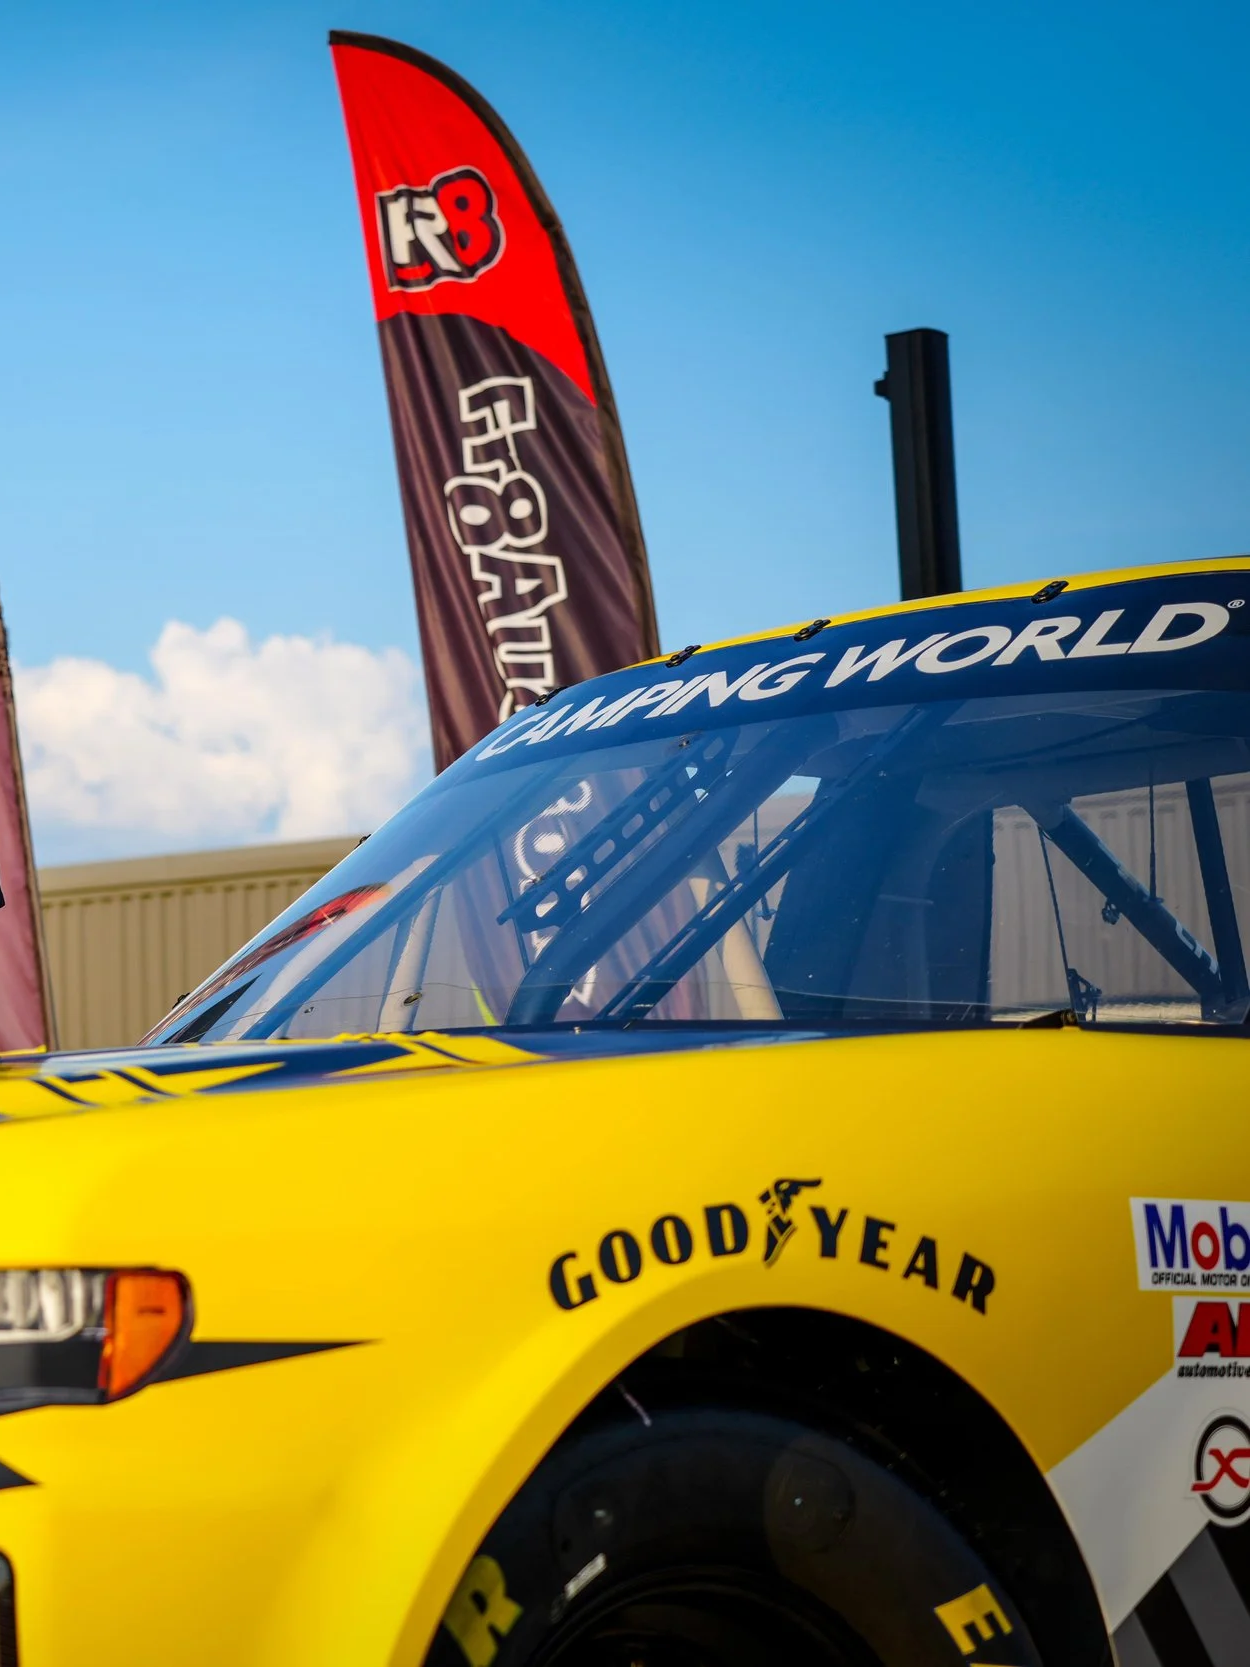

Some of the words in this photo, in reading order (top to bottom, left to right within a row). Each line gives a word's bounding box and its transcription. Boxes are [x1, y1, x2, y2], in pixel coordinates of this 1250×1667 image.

[475, 652, 825, 762] CAMPING
[823, 602, 1232, 689] WORLD
[547, 1202, 749, 1312] GOOD
[809, 1205, 996, 1317] YEAR
[1152, 1272, 1197, 1286] OFFICIAL
[1200, 1273, 1238, 1287] MOTOR
